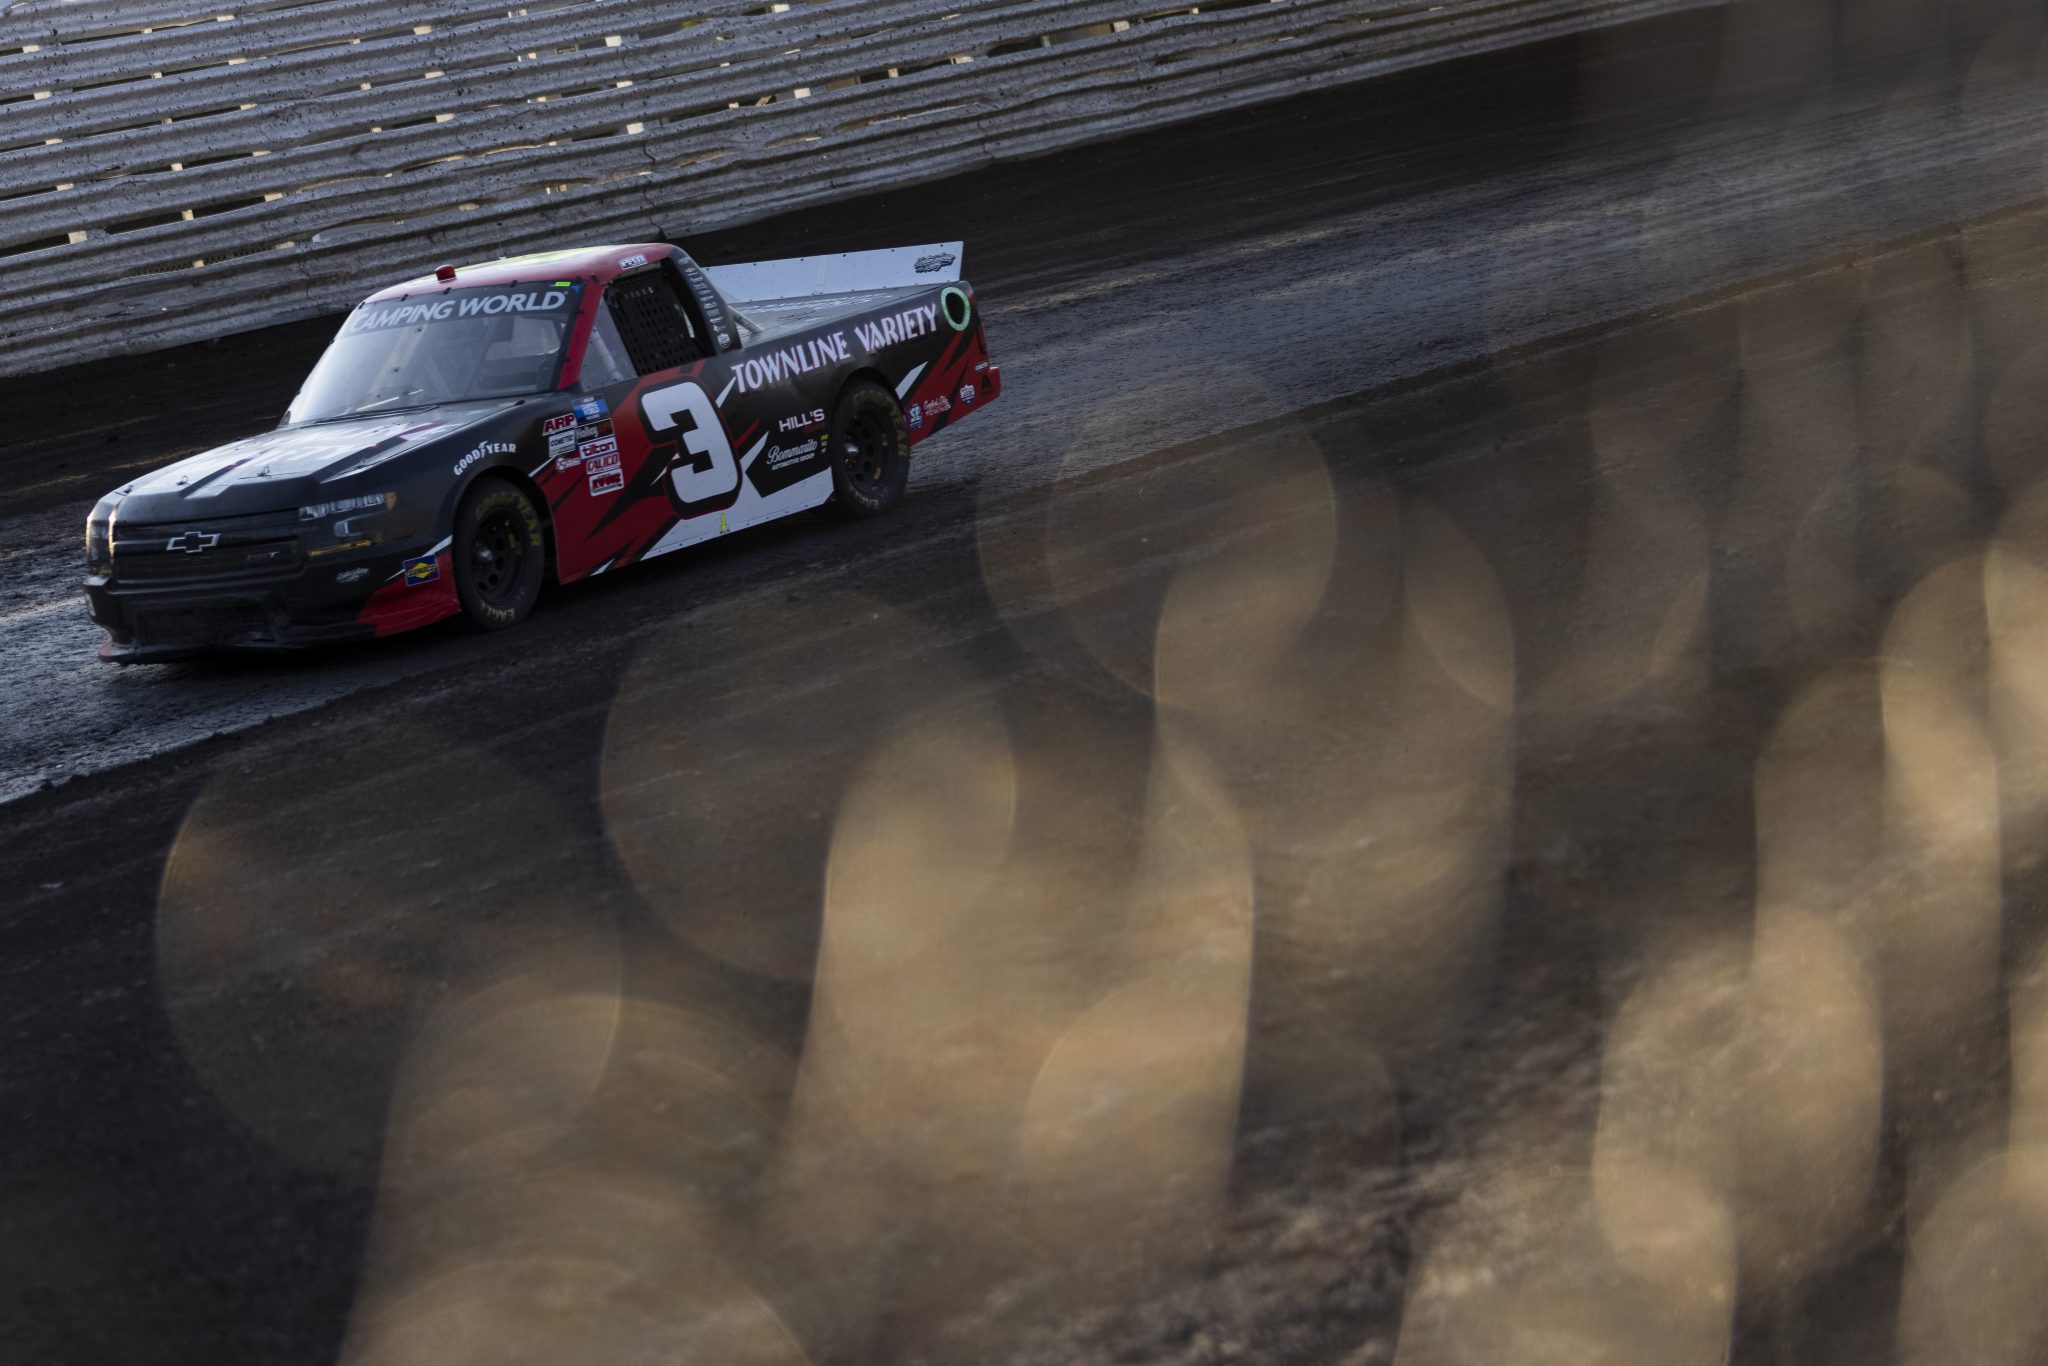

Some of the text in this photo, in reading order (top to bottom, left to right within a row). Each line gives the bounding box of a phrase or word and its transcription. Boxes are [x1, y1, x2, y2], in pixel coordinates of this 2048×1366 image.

[351, 291, 566, 332] CAMPING WORLD
[731, 331, 851, 394] TOWNLINE
[854, 303, 940, 353] VARIETY
[544, 413, 575, 433] ARP
[778, 408, 826, 433] HILL'S
[453, 440, 517, 476] GOODYEAR
[641, 381, 739, 503] 3
